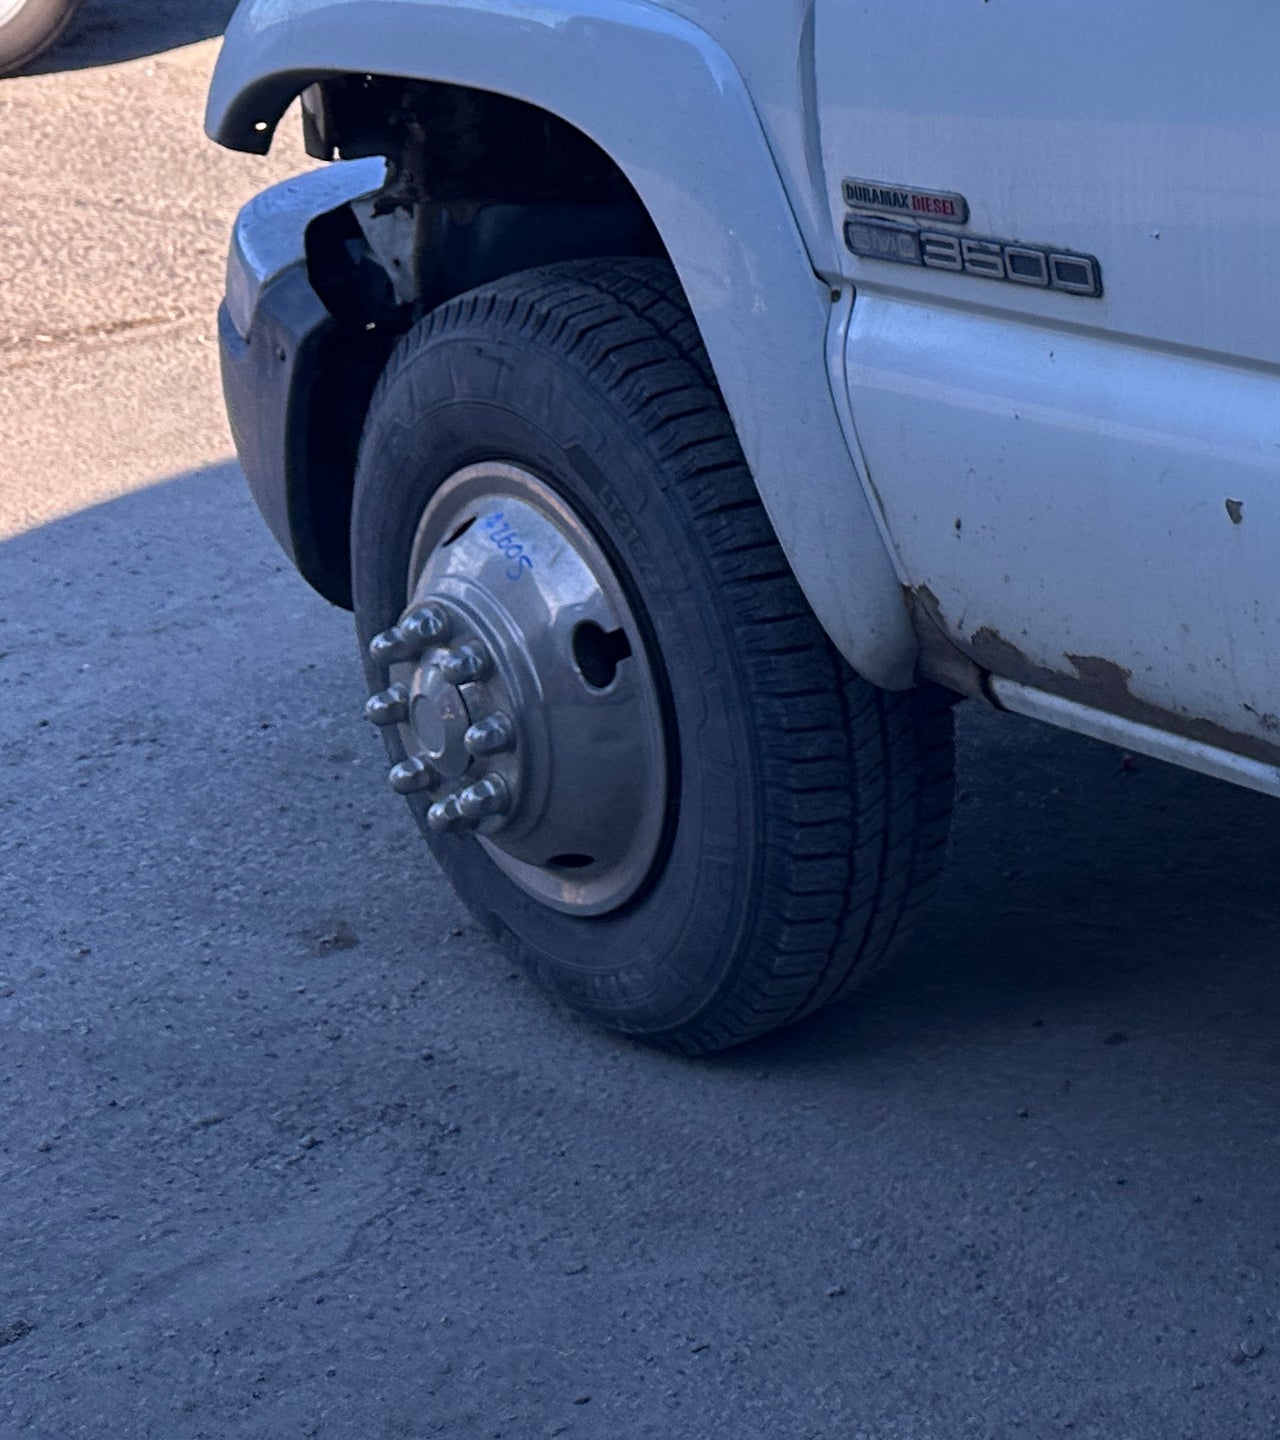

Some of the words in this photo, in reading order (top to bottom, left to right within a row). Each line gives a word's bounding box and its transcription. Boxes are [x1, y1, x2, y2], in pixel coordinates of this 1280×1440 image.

[845, 183, 910, 209] DURAMAX
[911, 194, 957, 217] DIESEL
[922, 233, 1095, 293] 3500
